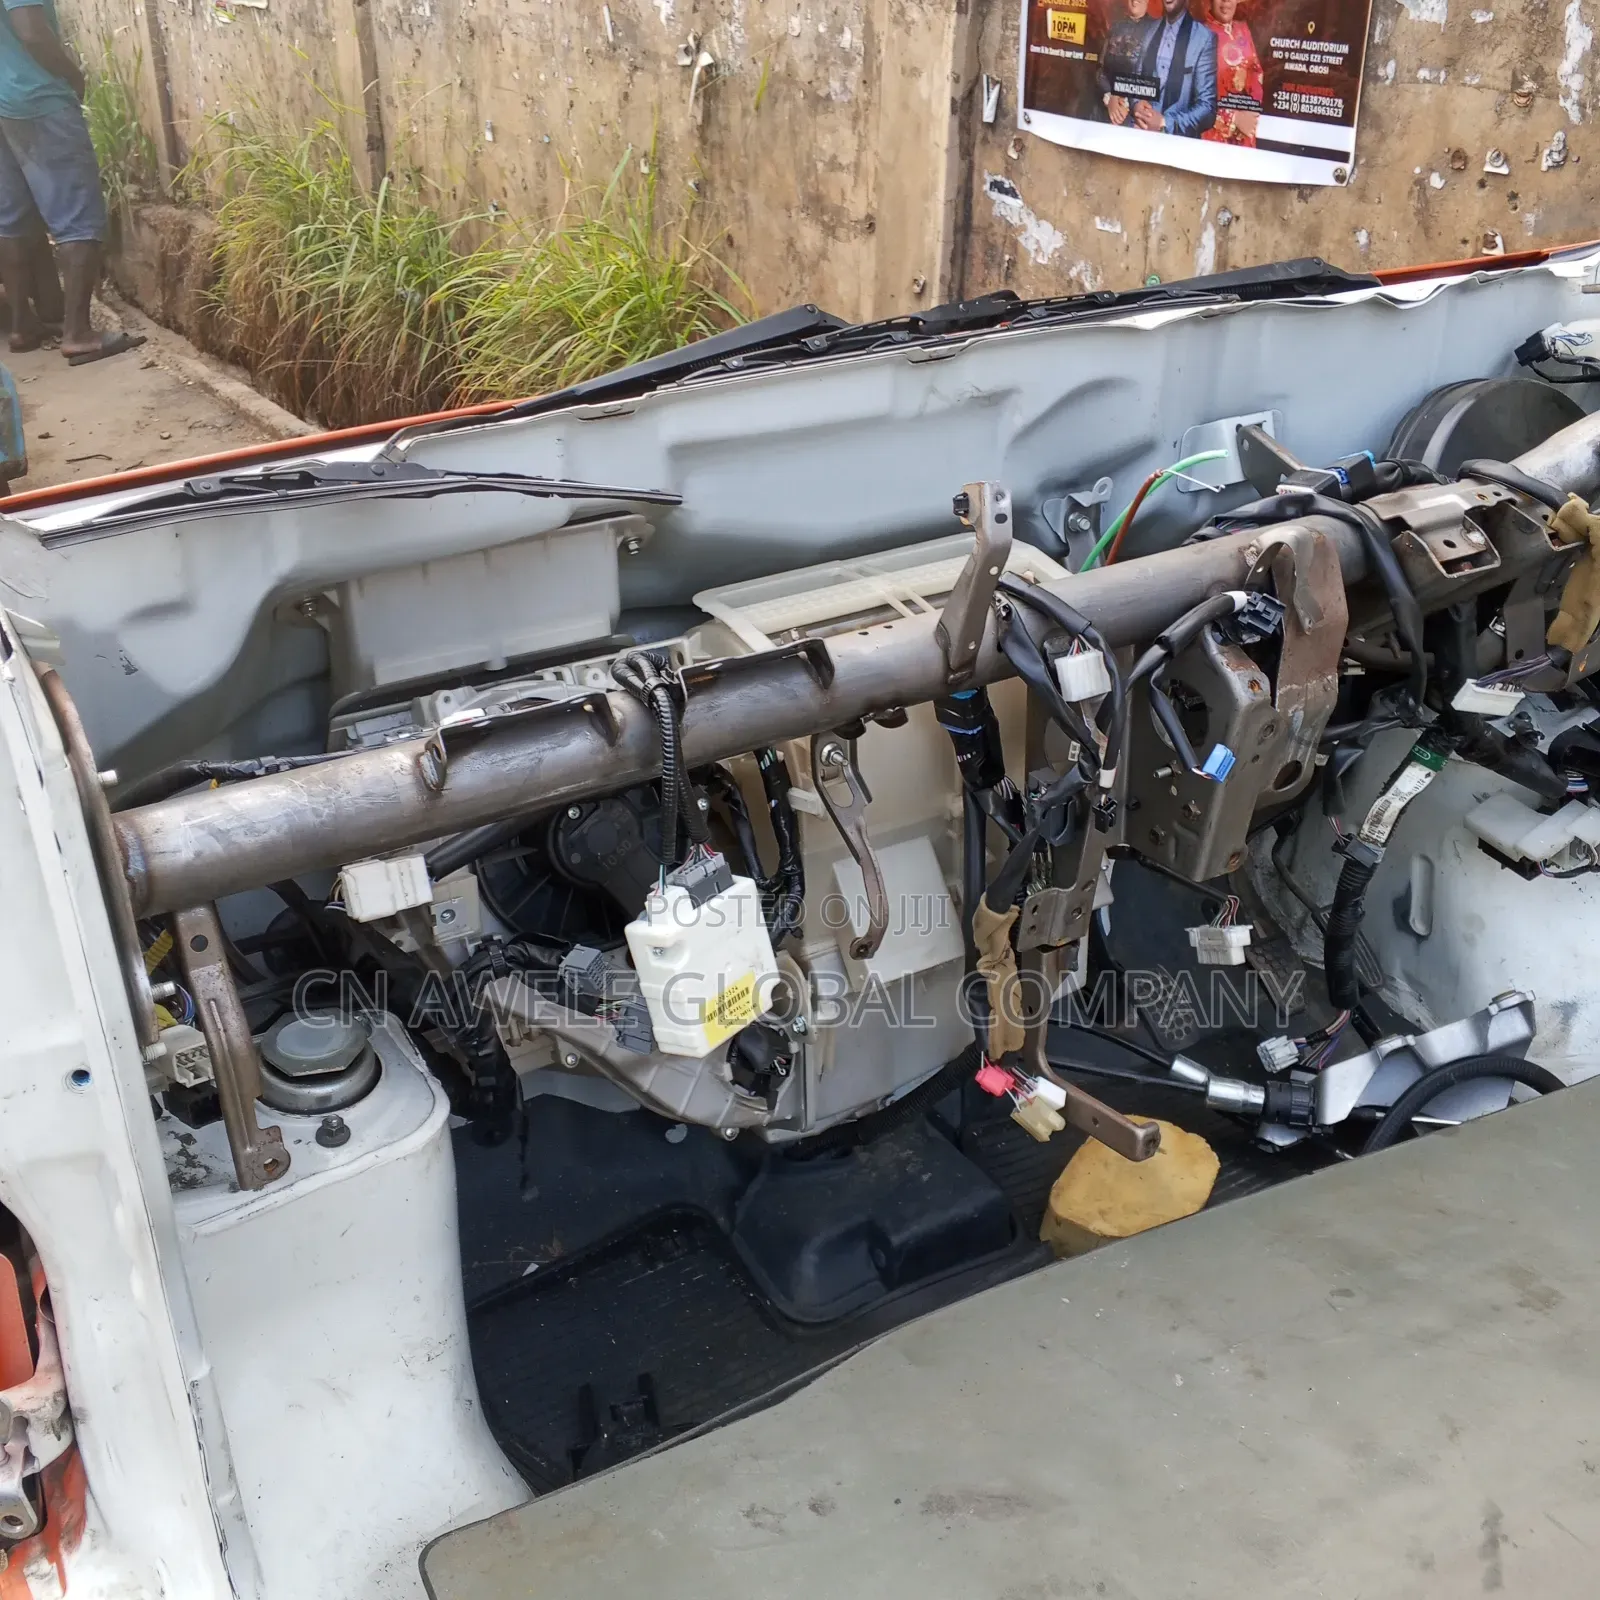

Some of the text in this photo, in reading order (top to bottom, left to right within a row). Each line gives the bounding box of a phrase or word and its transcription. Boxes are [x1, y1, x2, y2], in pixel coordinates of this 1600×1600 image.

[1053, 20, 1076, 33] 10PM
[1270, 37, 1349, 54] CHURCH AUDITORIUM
[1272, 50, 1343, 65] NO 9 GAIUS EZE STREET
[1284, 62, 1330, 75] AWADA, OBOSI
[1114, 81, 1157, 98] NWACHUKWU
[1273, 91, 1290, 101] +234
[1290, 92, 1300, 103] (0)
[1273, 101, 1290, 110] +234
[1290, 102, 1300, 114] (0)
[1301, 104, 1342, 118] 8034963623
